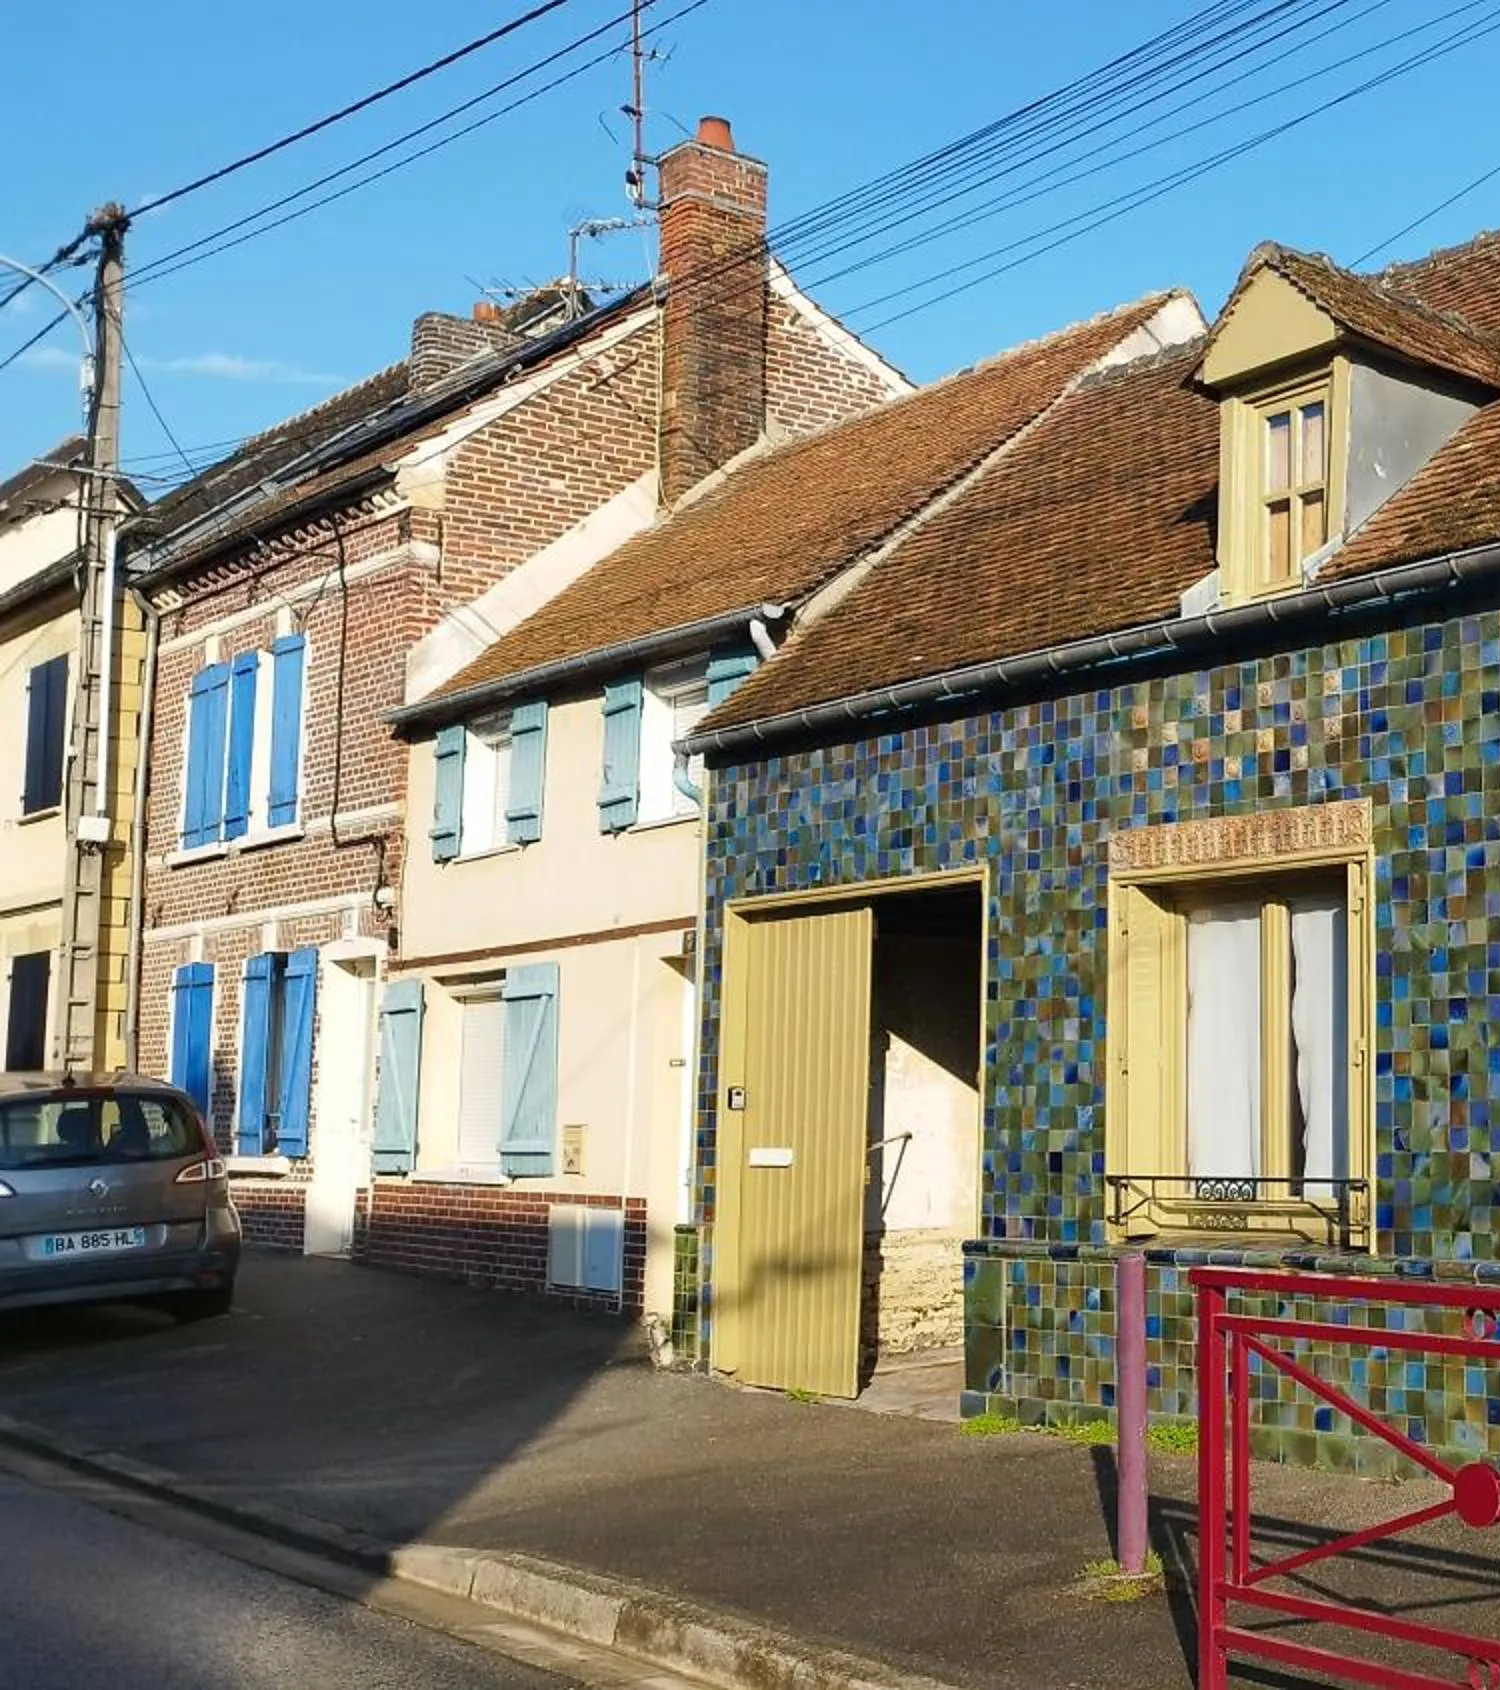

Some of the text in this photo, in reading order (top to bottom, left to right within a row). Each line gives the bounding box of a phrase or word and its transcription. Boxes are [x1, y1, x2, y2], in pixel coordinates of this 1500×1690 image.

[55, 1231, 134, 1252] BA 885 HL
